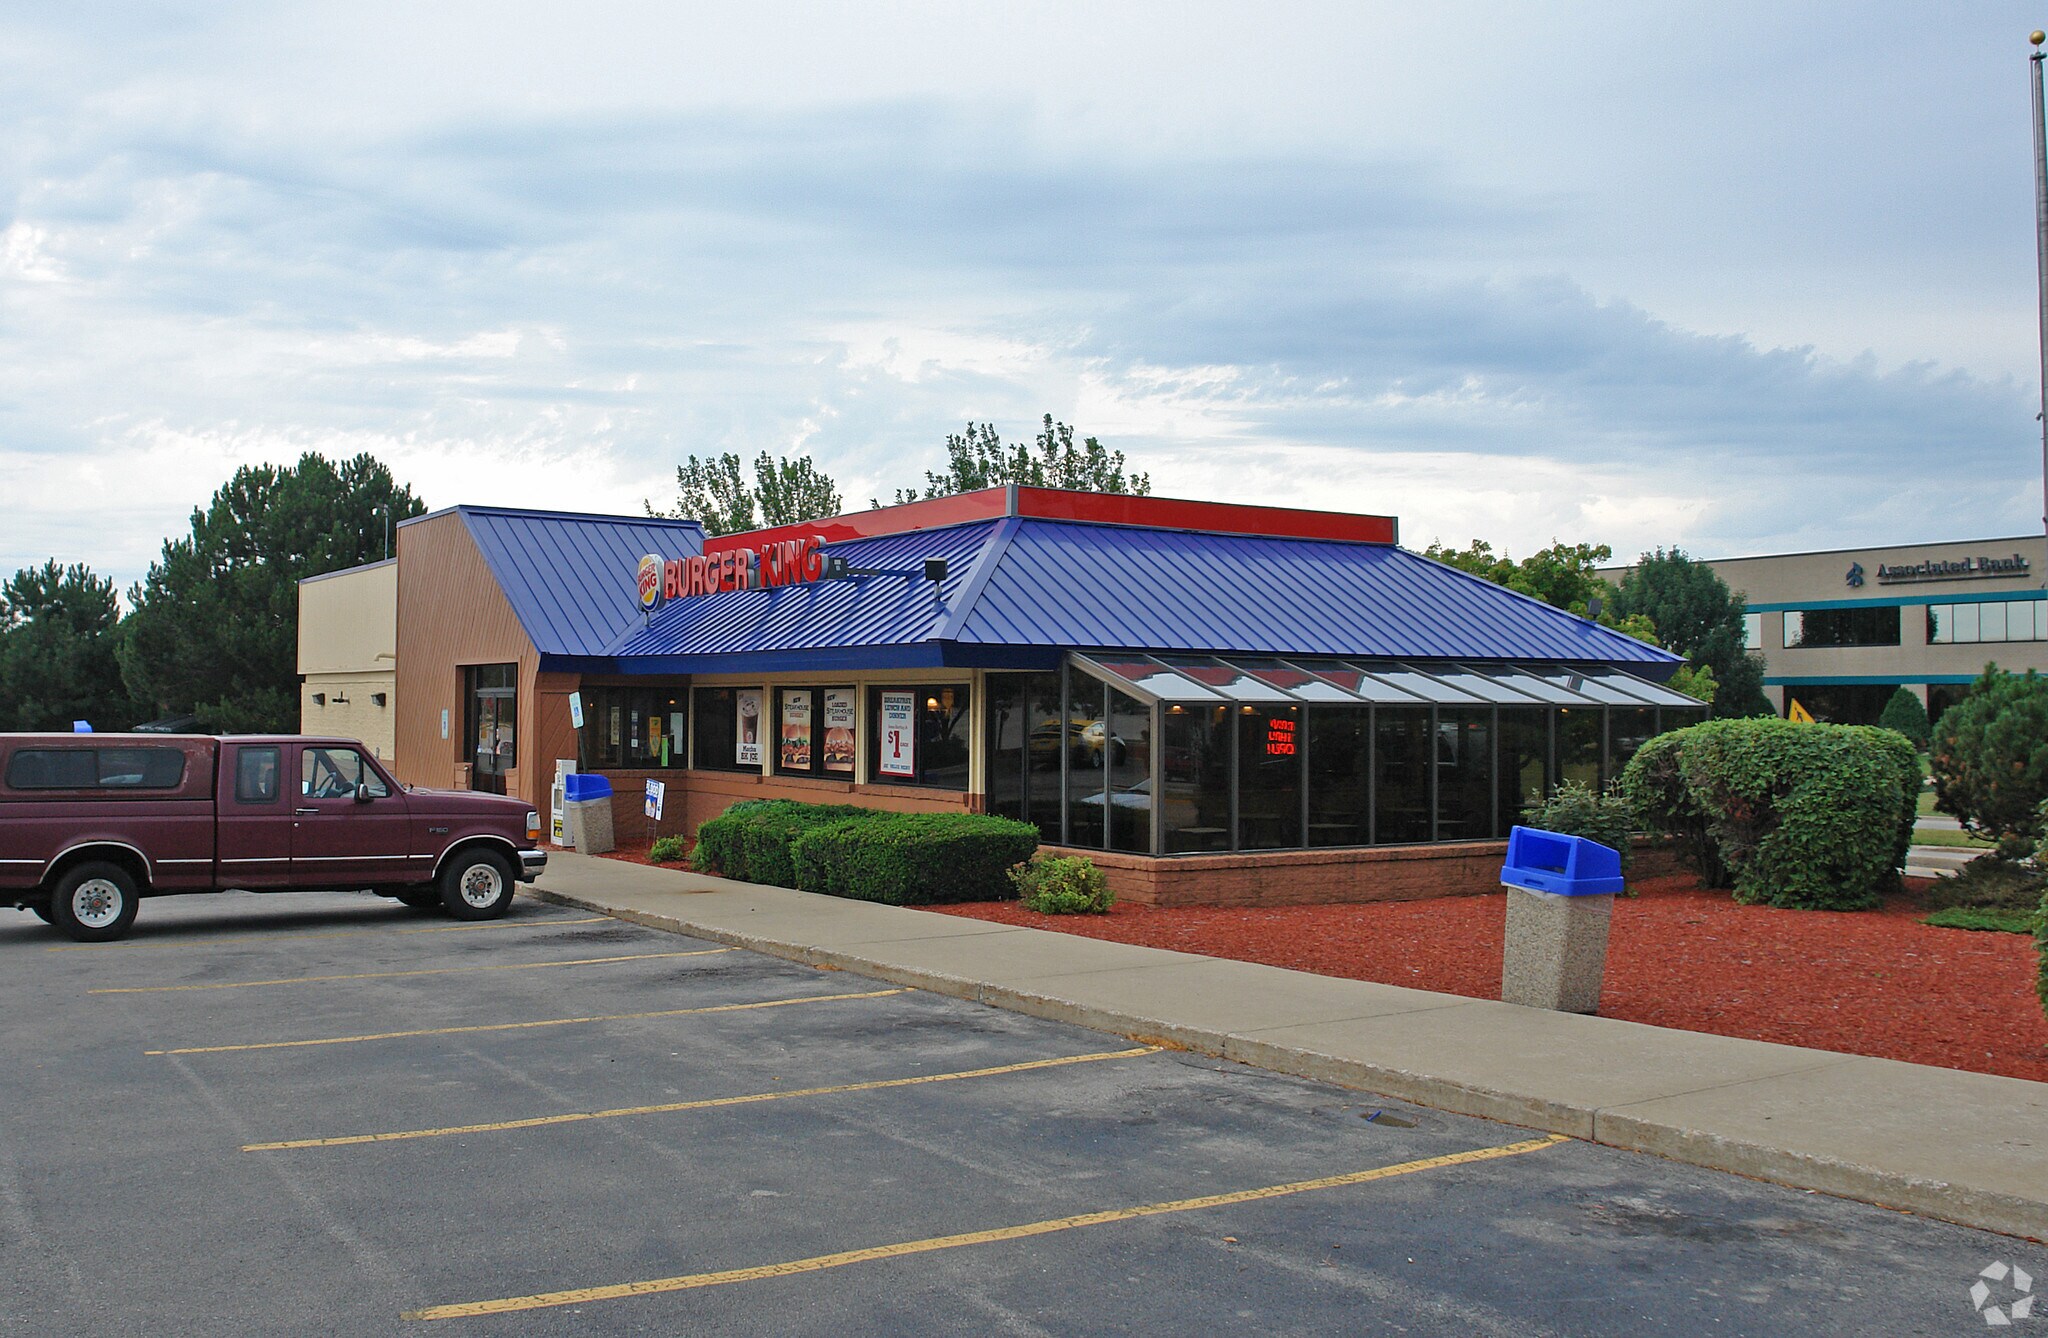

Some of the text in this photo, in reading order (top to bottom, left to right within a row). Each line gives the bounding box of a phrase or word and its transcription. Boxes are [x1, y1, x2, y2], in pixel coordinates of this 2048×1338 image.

[638, 563, 656, 585] BURGER
[664, 535, 827, 599] BURGER KING
[1877, 553, 2030, 577] Associated Bank
[639, 573, 657, 596] KING
[888, 730, 901, 758] $1
